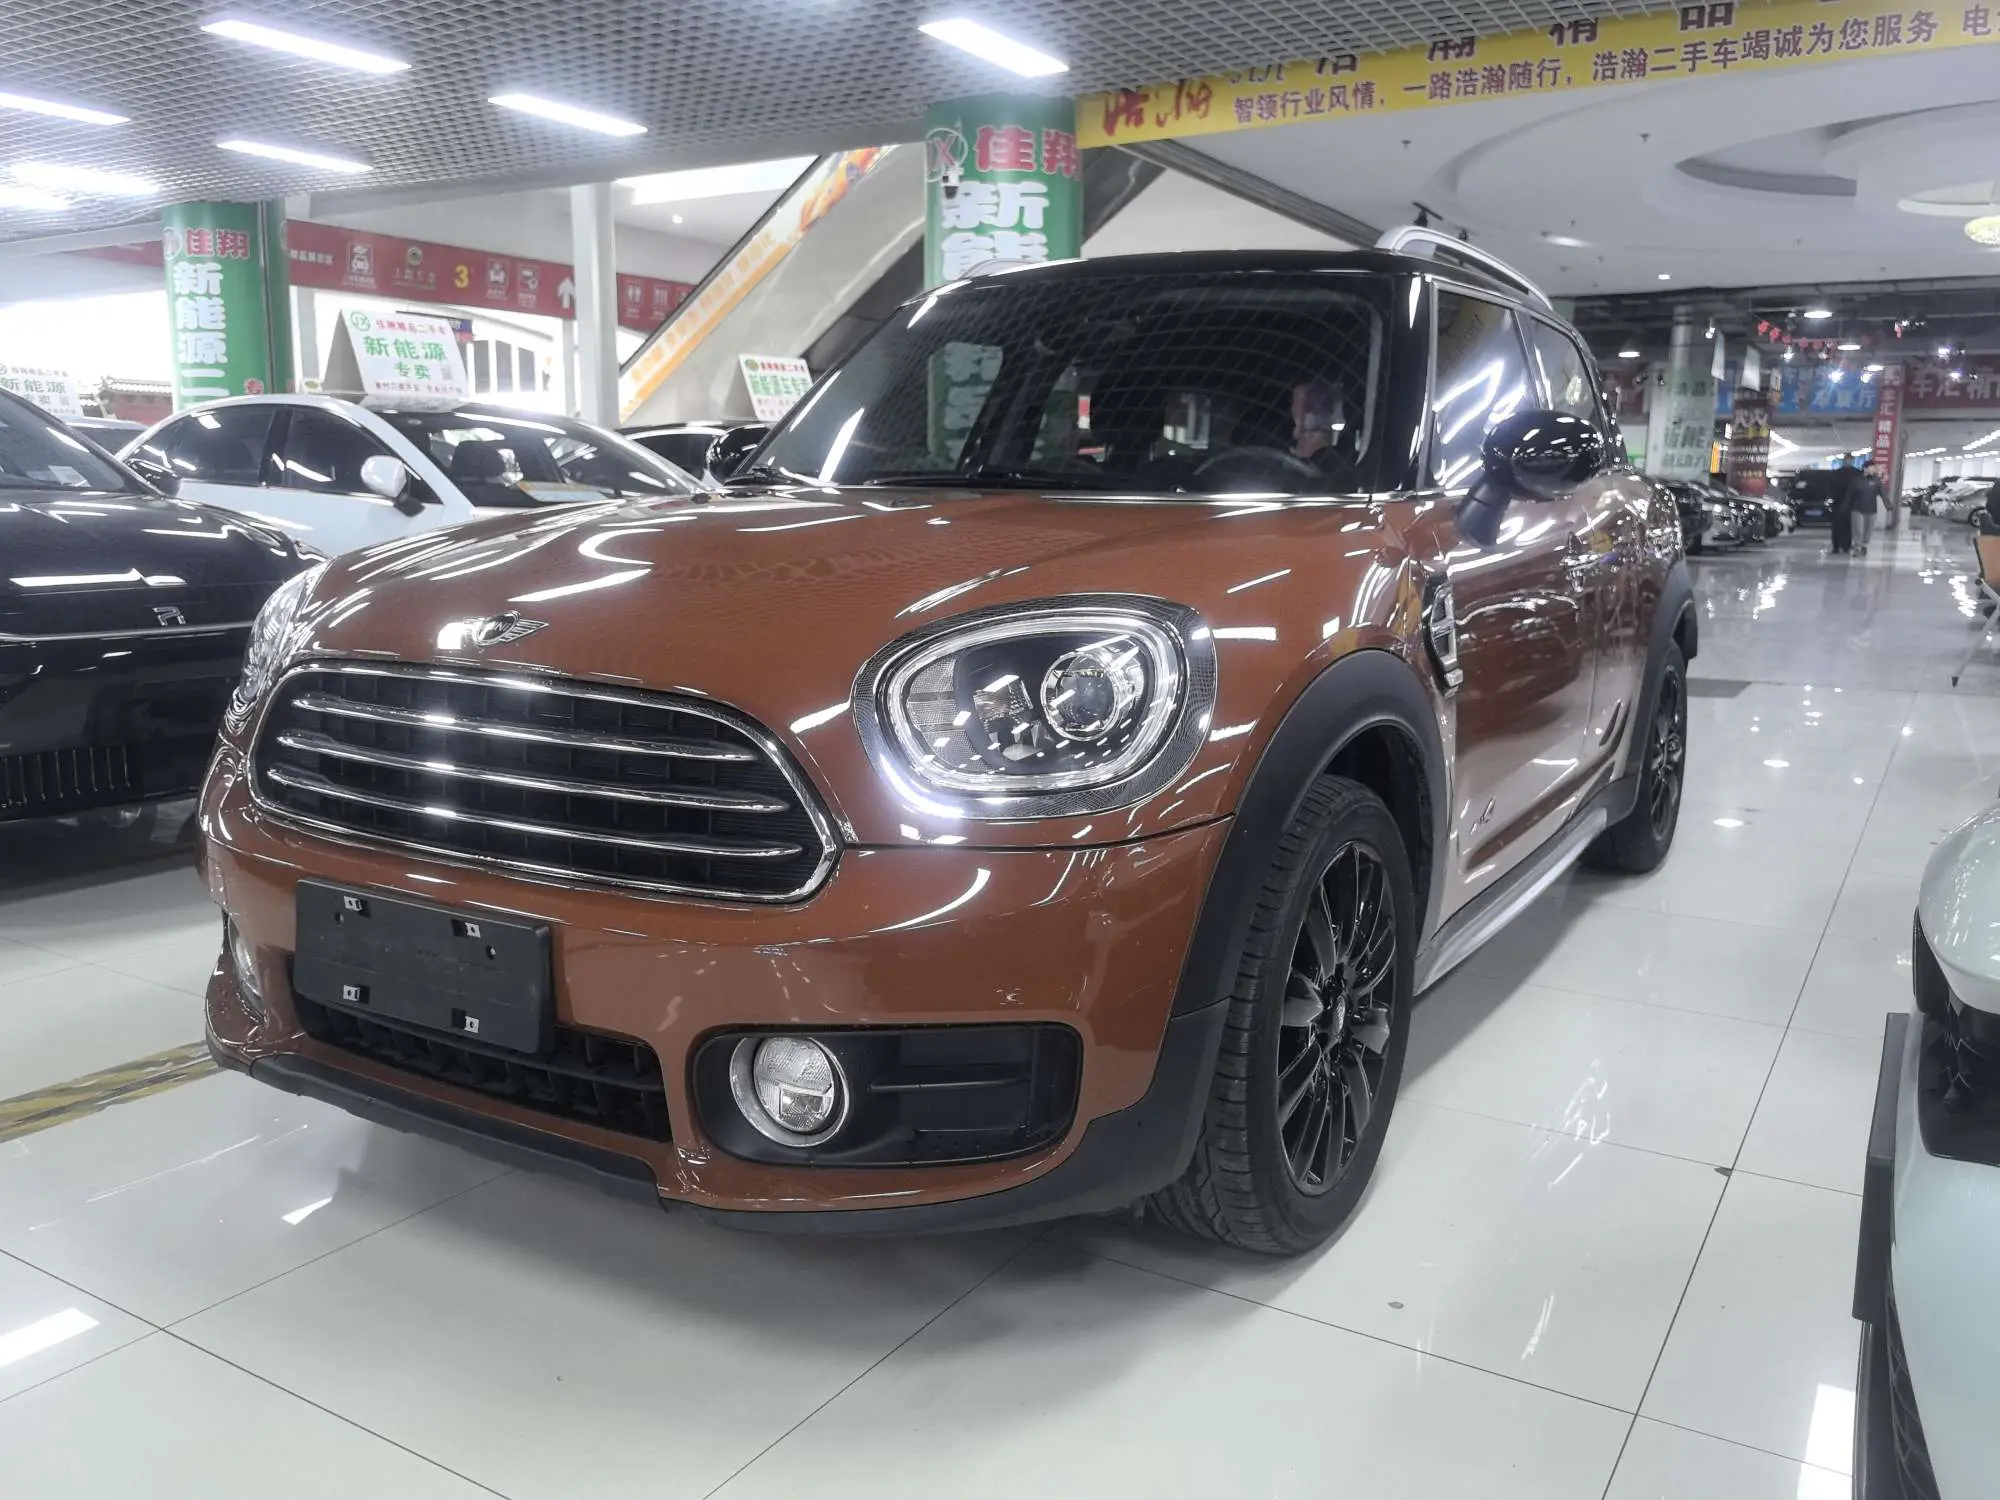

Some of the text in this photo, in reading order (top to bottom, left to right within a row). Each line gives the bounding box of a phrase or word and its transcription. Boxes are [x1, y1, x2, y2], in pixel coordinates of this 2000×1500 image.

[1962, 4, 2000, 37] 电
[185, 227, 250, 260] 佳翔
[362, 335, 448, 362] 新能源
